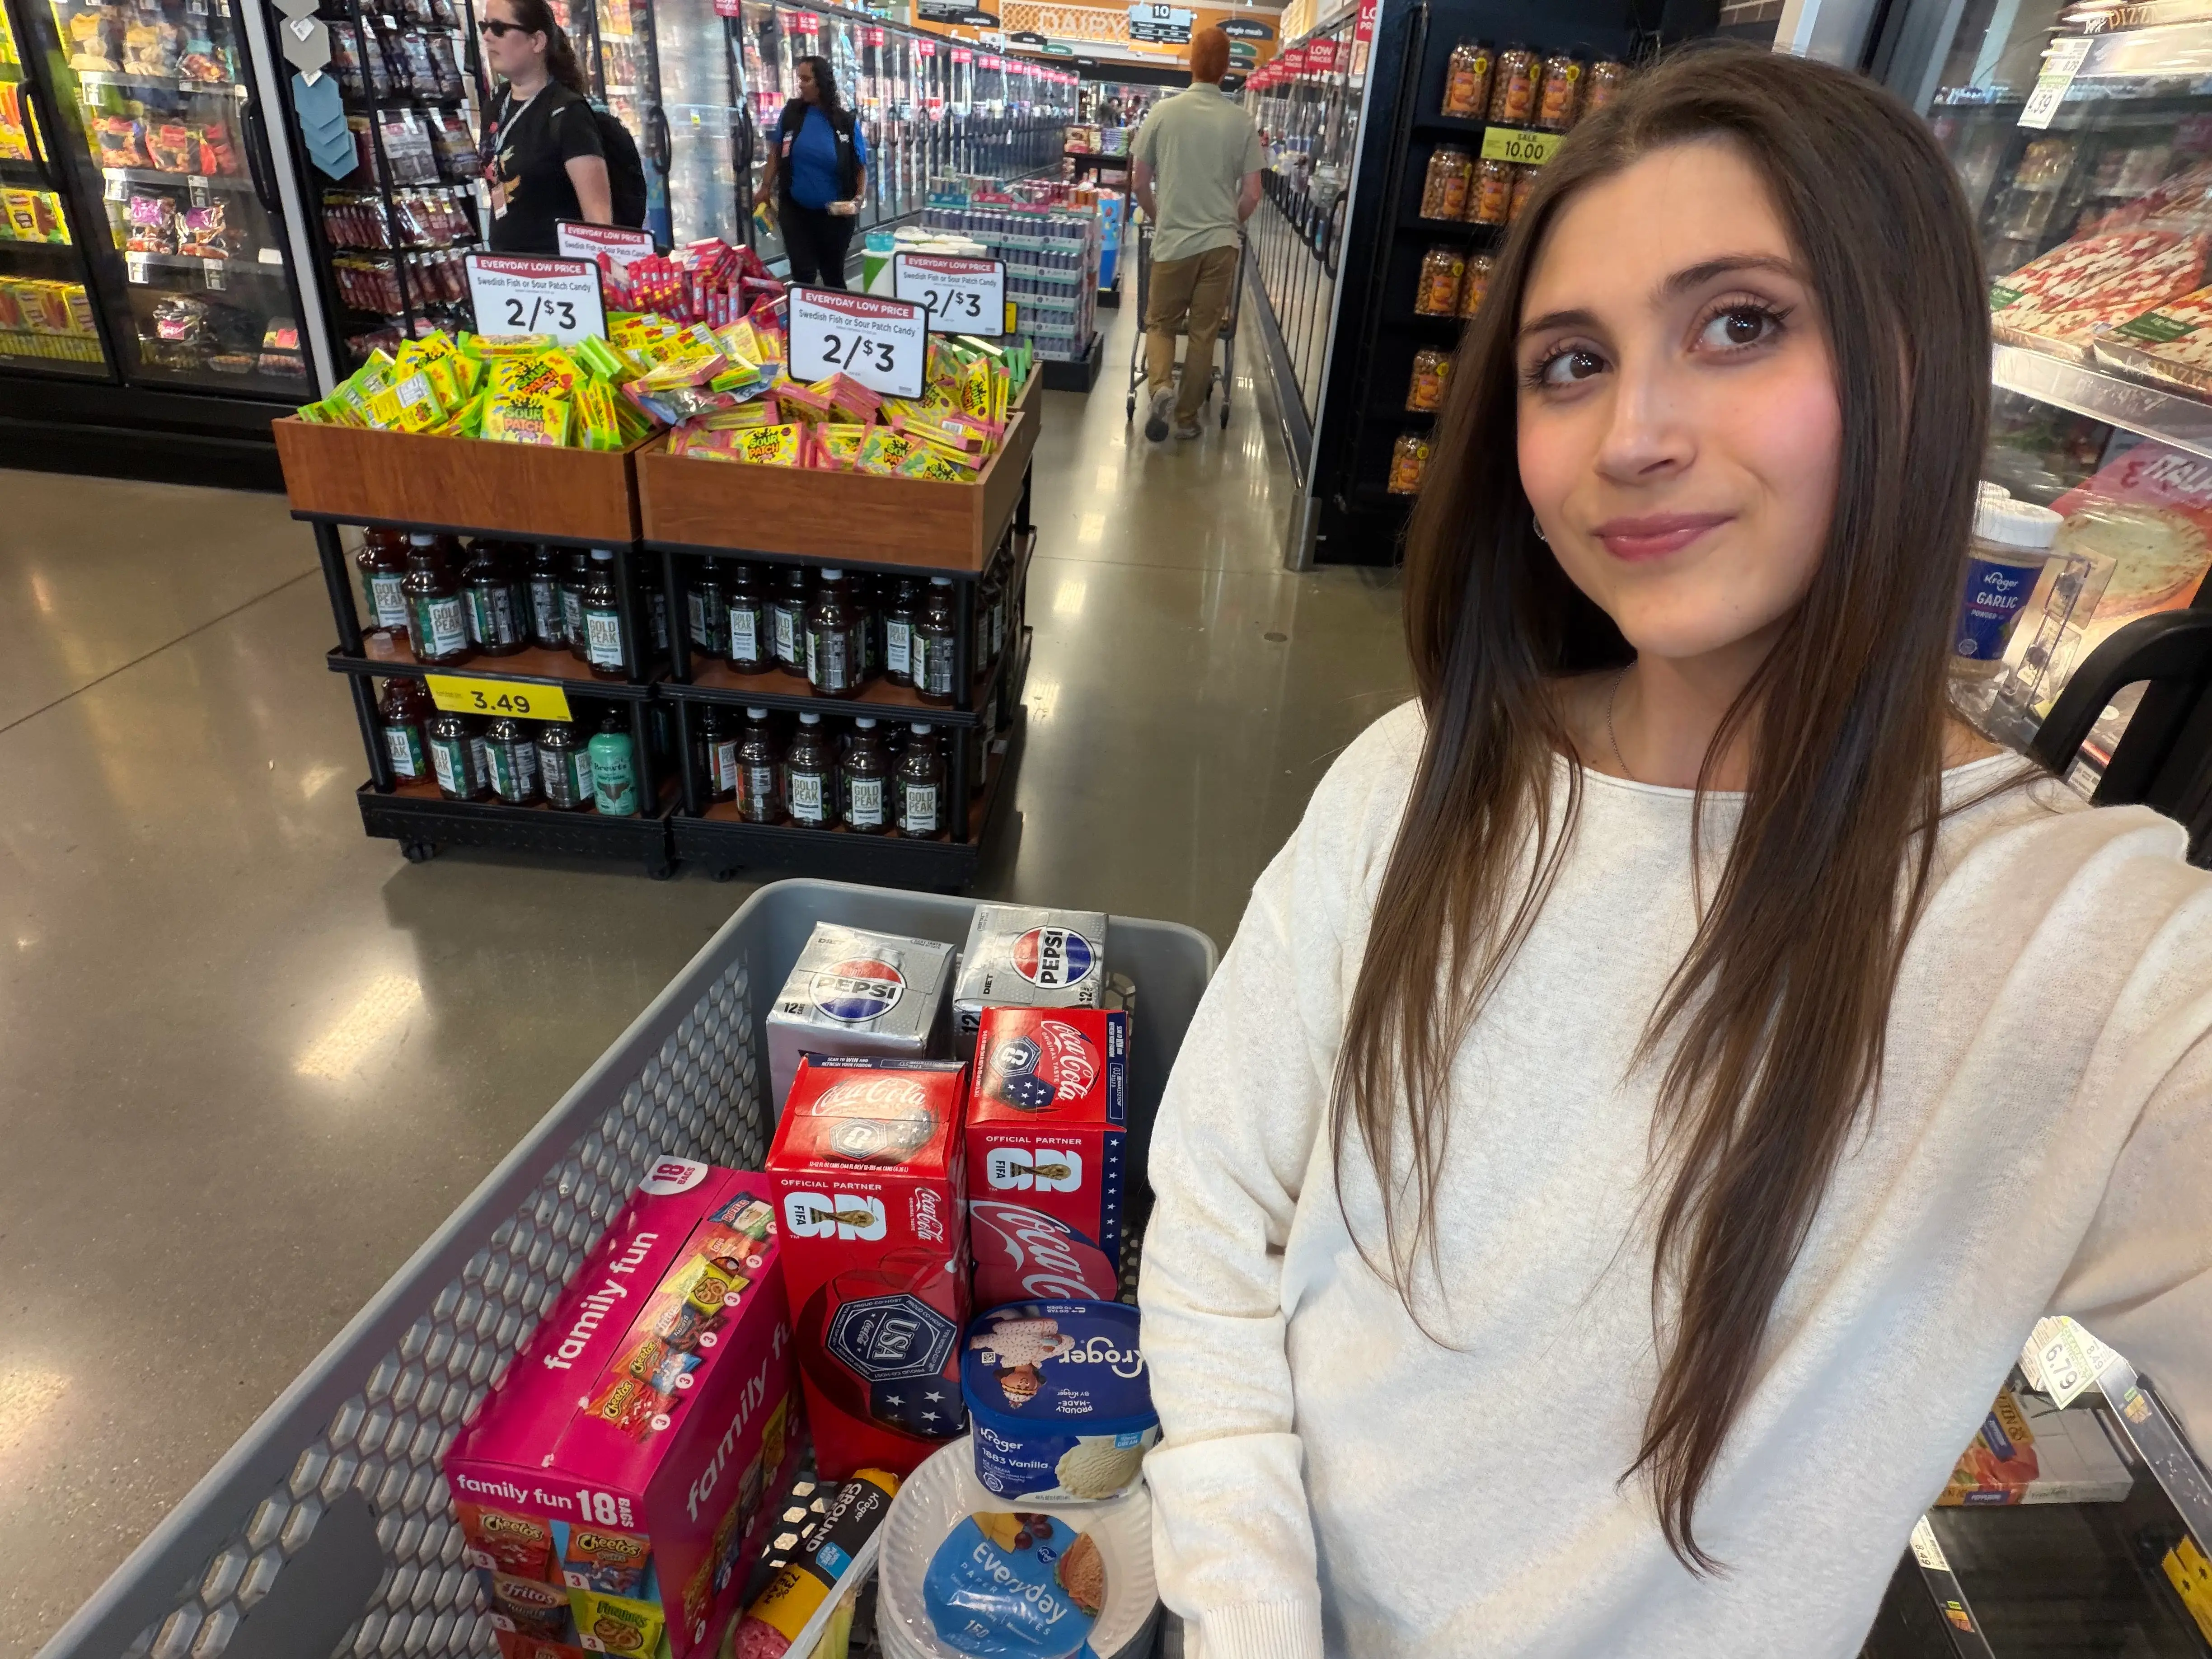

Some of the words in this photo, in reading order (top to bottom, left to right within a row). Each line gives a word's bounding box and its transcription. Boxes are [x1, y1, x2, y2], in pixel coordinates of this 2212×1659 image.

[1154, 5, 1169, 17] 10
[1362, 6, 1377, 20] LO
[1040, 11, 1126, 36] DAIRY
[1310, 45, 1333, 56] LOW
[1505, 141, 1544, 159] 10.00
[567, 226, 602, 237] EVERYDAY
[604, 232, 620, 240] LOW
[621, 234, 642, 243] PRICE
[481, 259, 529, 270] EVERYDAY
[531, 263, 552, 272] LOW
[554, 265, 582, 273] PRICE
[908, 258, 948, 267] EVERYDAY
[968, 263, 992, 271] PRICE
[477, 276, 504, 286] Swedish
[506, 278, 521, 287] Fish
[531, 280, 547, 289] Sour
[549, 281, 568, 290] Patch
[569, 282, 591, 292] Candy
[904, 272, 926, 280] Swedish
[979, 278, 997, 288] Candy
[806, 292, 855, 308] EVERYDAY
[856, 301, 879, 312] LOW
[881, 305, 909, 317] PRICE
[924, 289, 981, 318] 2/$3
[505, 296, 576, 332] 2/$3
[799, 309, 827, 321] Swedish
[829, 314, 843, 323] Fish
[854, 319, 870, 329] Sour
[872, 321, 891, 332] Patch
[893, 325, 916, 337] Candy
[822, 334, 895, 372] 2/$3
[516, 363, 551, 389] SOUR
[521, 367, 559, 395] PATCH
[972, 380, 981, 406] SOUR
[505, 406, 544, 420] SOUR
[504, 417, 545, 432] PATCH
[749, 434, 778, 448] SOUR
[749, 442, 780, 459] PATCH
[1983, 572, 2019, 591] Kroger
[1976, 591, 2019, 609] GARLIC
[433, 605, 459, 620] GOLD
[733, 613, 751, 622] GOLD
[1971, 609, 1997, 619] POWDER
[434, 619, 460, 632] PEAK
[590, 619, 615, 632] GOLD
[733, 621, 751, 630] PEAK
[591, 632, 616, 643] PEAK
[470, 690, 530, 713] 3.49
[794, 778, 818, 791] GOLD
[854, 785, 879, 796] GOLD
[795, 789, 818, 801] PEAK
[855, 795, 879, 806] PEAK
[909, 791, 933, 802] GOLD
[909, 801, 933, 812] PEAK
[1040, 931, 1063, 984] PEPSI
[815, 977, 897, 999] PEPSI
[983, 973, 994, 994] DIET
[1079, 992, 1092, 1002] 12
[784, 1002, 798, 1014] 12
[797, 1003, 806, 1015] CANS
[1041, 1031, 1054, 1060] ORIGINAL
[1041, 1019, 1094, 1101] Coca-Cola
[811, 1078, 926, 1116] Coca-Cola
[652, 1164, 686, 1181] 18
[678, 1167, 696, 1185] BAGS
[996, 1160, 1006, 1179] FIFA
[781, 1179, 829, 1188] OFFICIAL
[833, 1182, 882, 1190] PARTNER
[722, 1199, 750, 1223] RUFFLES
[794, 1205, 806, 1226] FIFA
[914, 1187, 944, 1243] Coca-Cola
[543, 1279, 628, 1370] family
[609, 1233, 659, 1274] fun
[906, 1300, 923, 1313] PROUD
[872, 1318, 920, 1359] USA
[631, 1341, 657, 1373] Cheetos
[2062, 1327, 2093, 1378] CLEARANCE
[2086, 1345, 2103, 1370] 8.49
[2046, 1343, 2077, 1390] 6.79
[604, 1381, 634, 1417] Cheetos
[1057, 1388, 1079, 1399] Kroger
[1055, 1406, 1093, 1414] PROUDLY
[687, 1357, 768, 1523] family
[980, 1427, 1023, 1452] Kroger
[982, 1447, 1006, 1464] 1883
[1009, 1459, 1049, 1469] Vanilla
[457, 1474, 528, 1503] family
[534, 1488, 572, 1510] fun
[576, 1489, 618, 1526] 18
[855, 1492, 880, 1522] Kroger
[618, 1497, 634, 1528] BAGS
[806, 1483, 862, 1552] GROUND
[483, 1515, 543, 1540] Cheetos
[578, 1534, 641, 1557] Cheetos
[1915, 1544, 1931, 1565] 8.49
[478, 1554, 489, 1566] 3
[571, 1575, 582, 1586] 3
[961, 1562, 998, 1593] PAPER
[973, 1542, 1068, 1625] Everyday
[587, 1637, 599, 1649] 3
